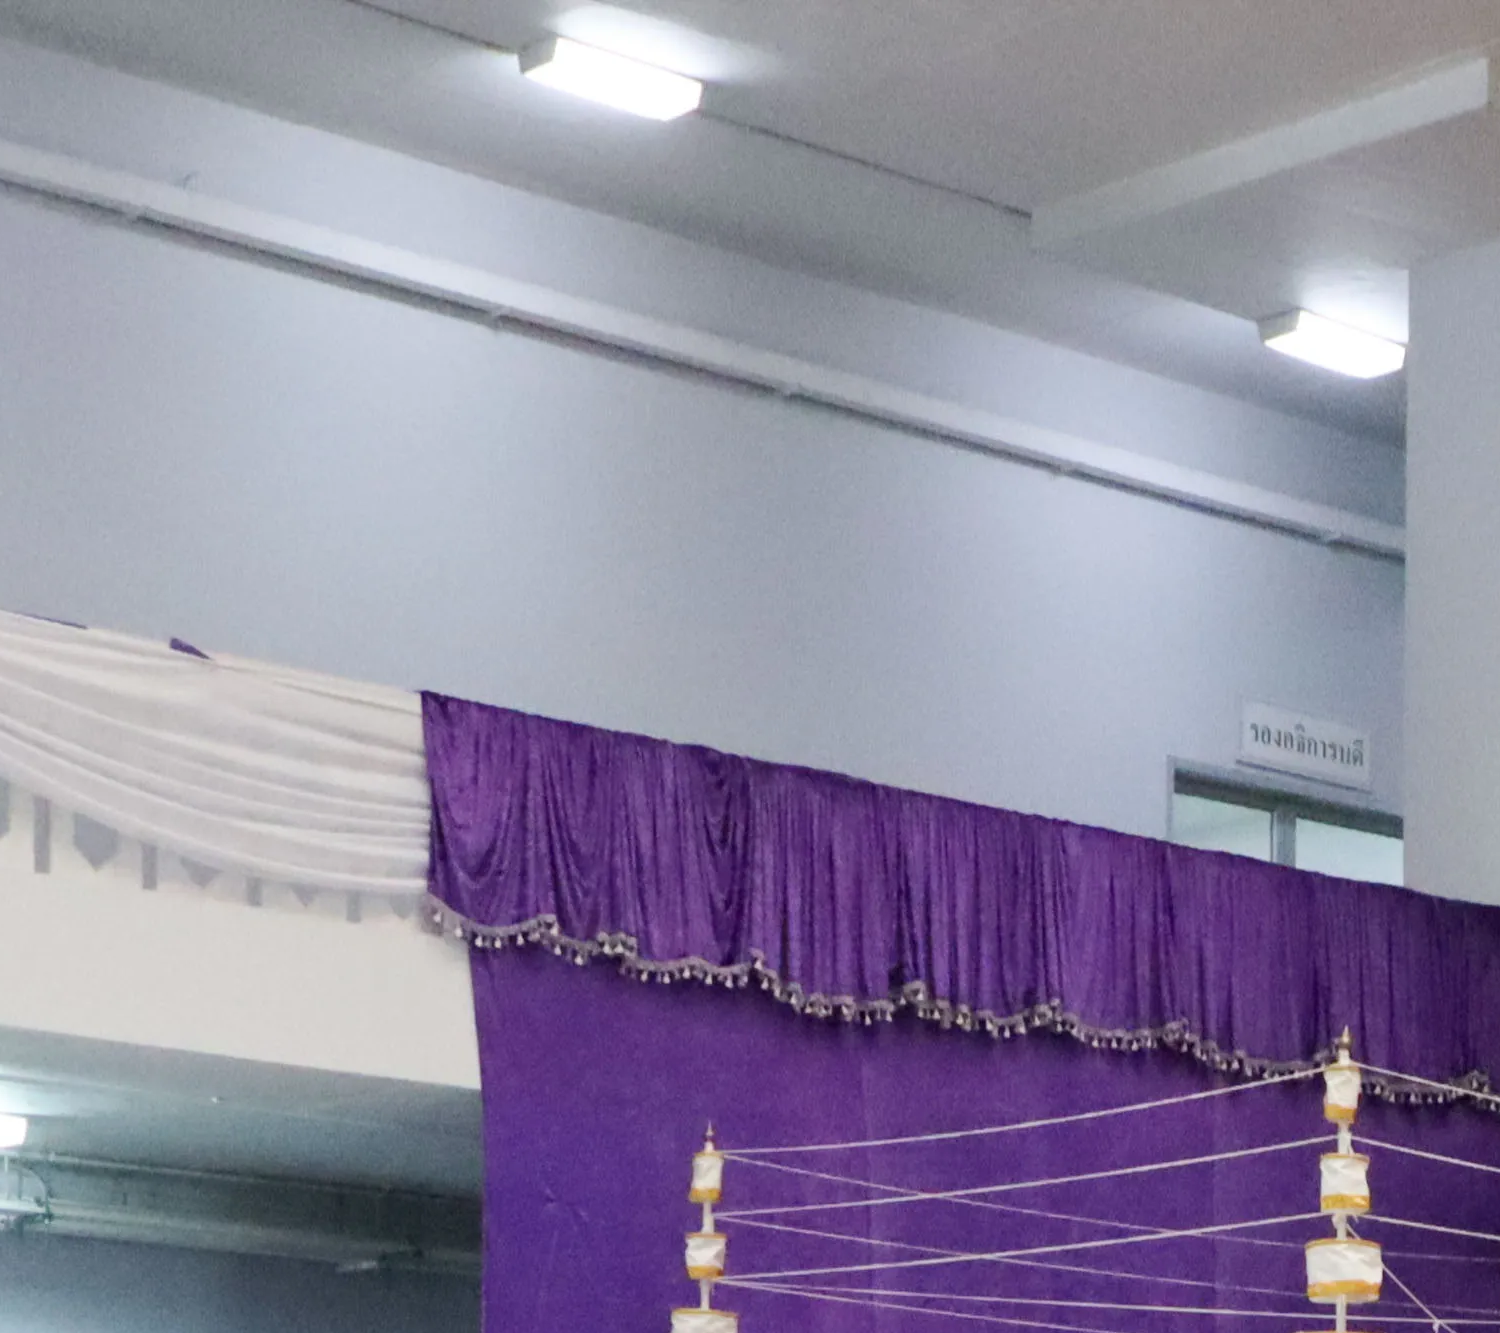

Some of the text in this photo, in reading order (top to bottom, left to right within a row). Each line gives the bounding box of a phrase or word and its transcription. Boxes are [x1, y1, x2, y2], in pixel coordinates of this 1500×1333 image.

[1250, 722, 1365, 767] รองอธิการบดี
